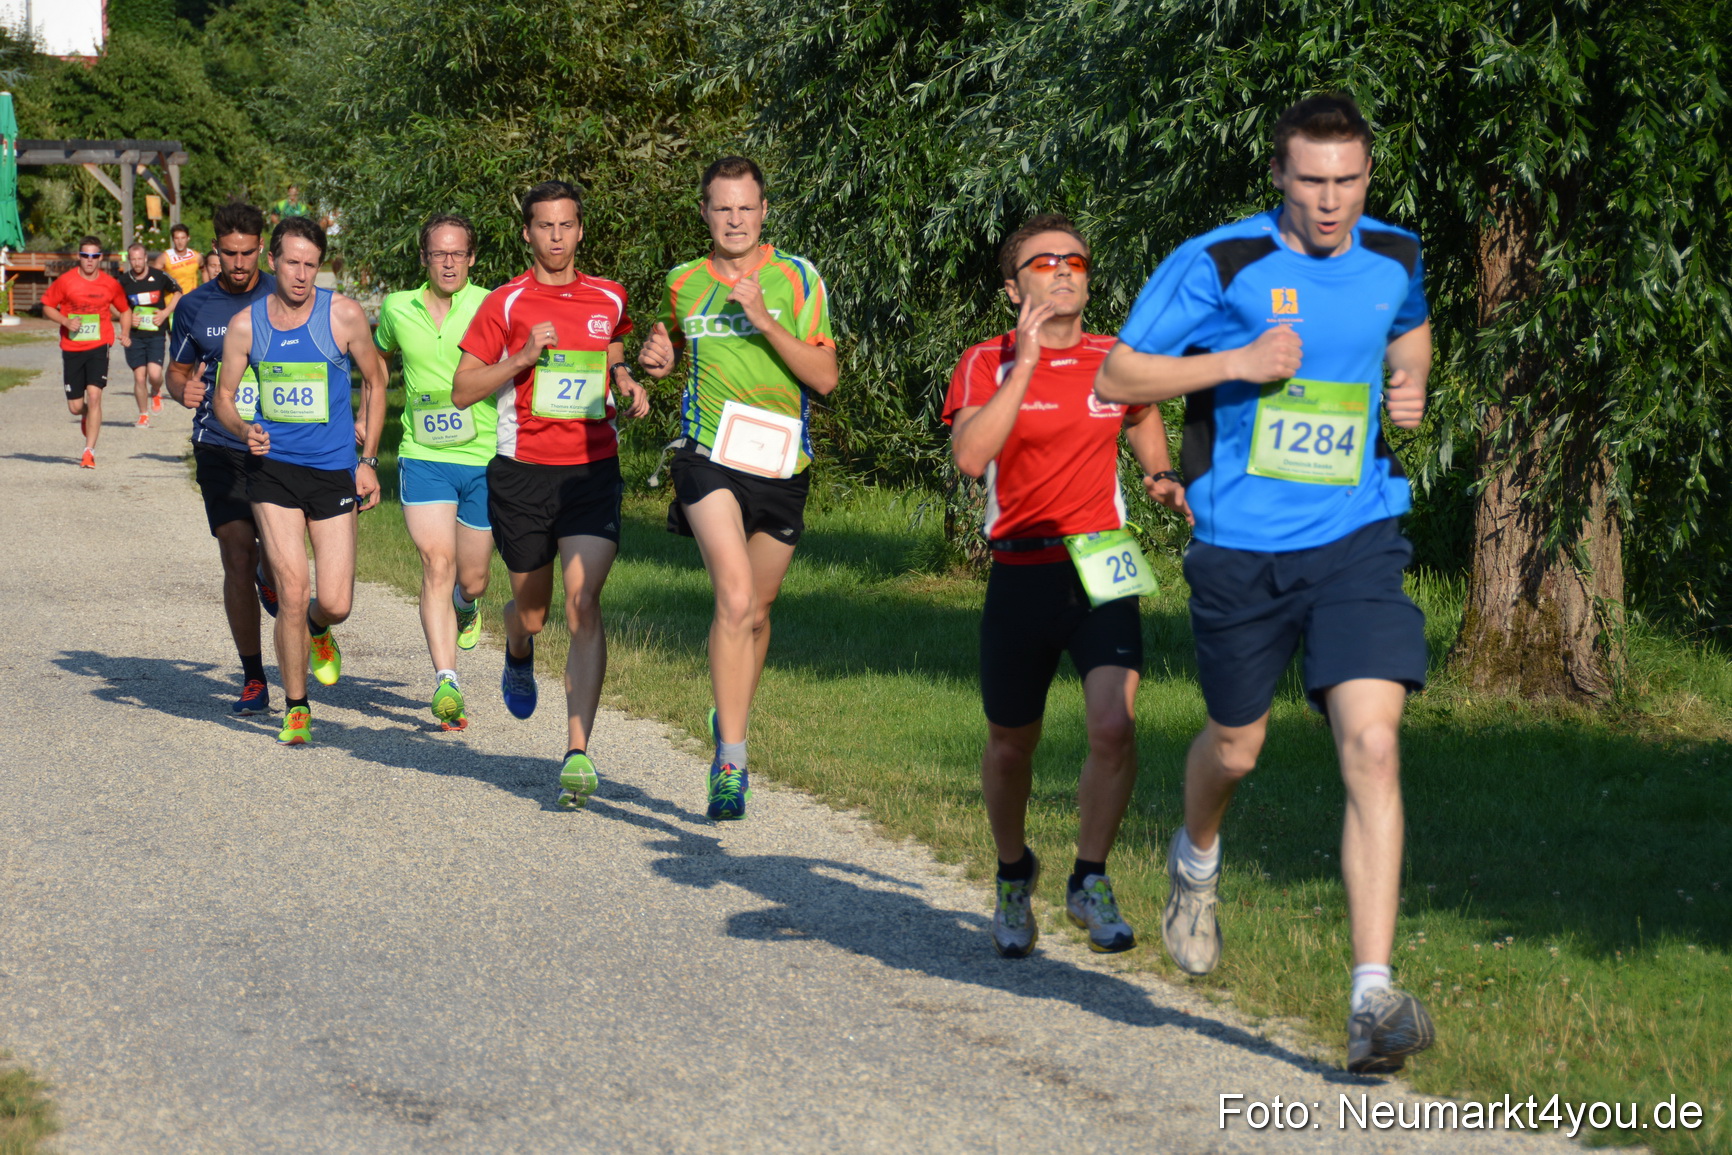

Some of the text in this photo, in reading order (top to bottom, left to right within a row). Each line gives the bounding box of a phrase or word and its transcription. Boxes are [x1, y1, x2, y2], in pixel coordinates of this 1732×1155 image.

[273, 386, 314, 406] 648
[557, 378, 587, 400] 27
[423, 412, 463, 433] 656
[1268, 418, 1355, 457] 1284
[1106, 551, 1138, 584] 28
